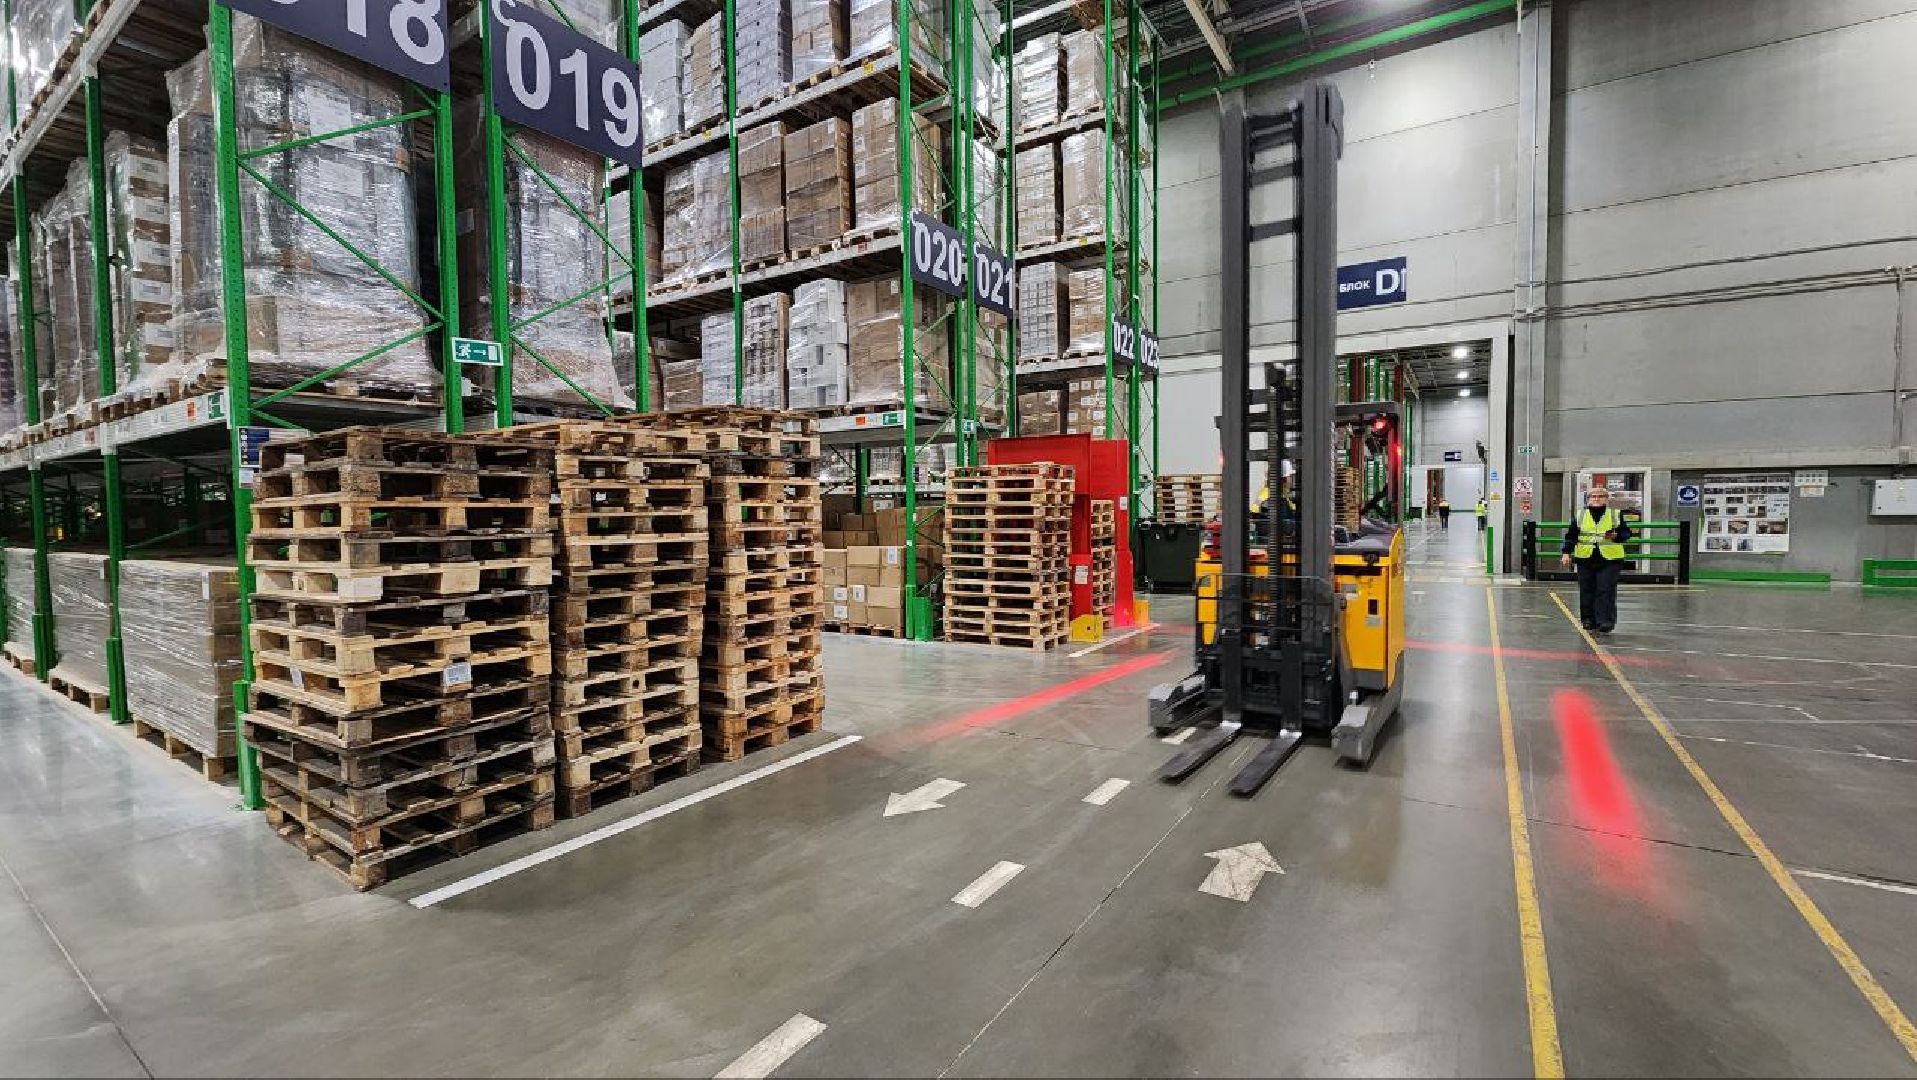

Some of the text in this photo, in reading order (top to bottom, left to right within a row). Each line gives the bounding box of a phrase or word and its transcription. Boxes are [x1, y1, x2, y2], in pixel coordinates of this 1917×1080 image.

[506, 21, 639, 148] 019
[914, 222, 961, 287] 020
[977, 254, 1013, 309] 021
[1339, 280, 1371, 293] БЛОК
[1113, 321, 1134, 360] 022
